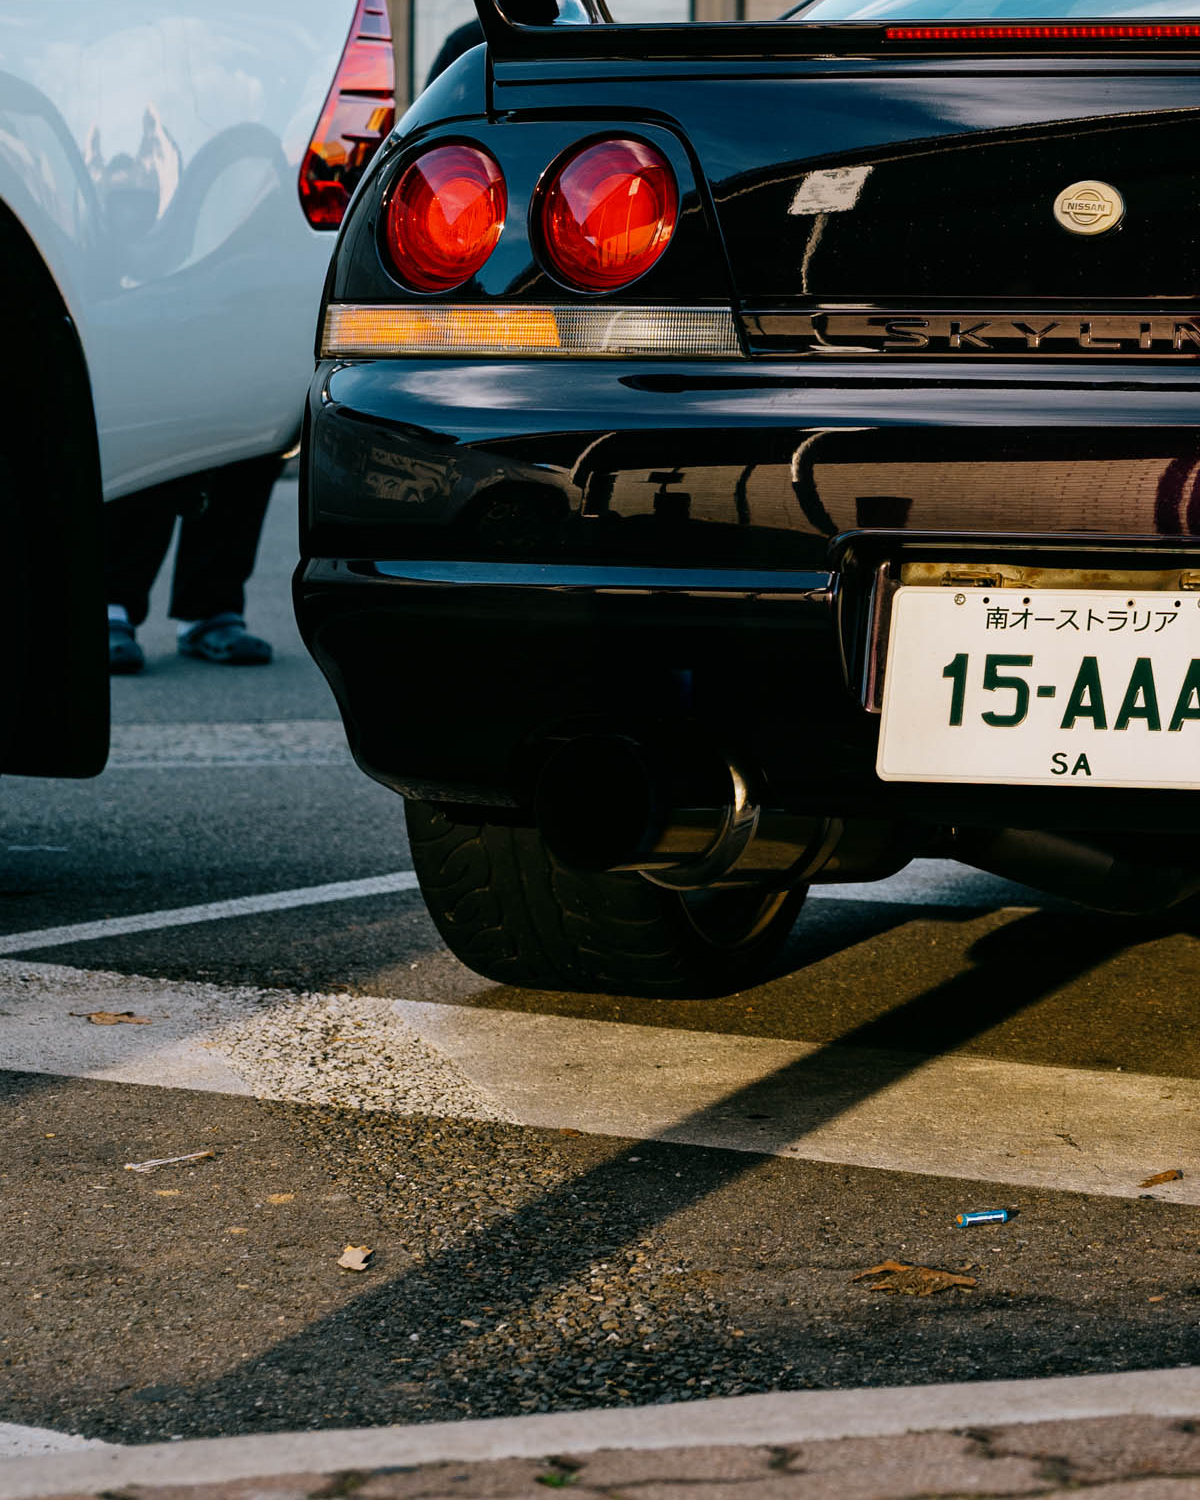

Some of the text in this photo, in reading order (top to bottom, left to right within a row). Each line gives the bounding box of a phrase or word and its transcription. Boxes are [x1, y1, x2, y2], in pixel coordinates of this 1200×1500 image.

[1067, 202, 1106, 212] NISSAN
[985, 607, 1179, 633] 南オーストラリア
[1050, 752, 1092, 777] SA
